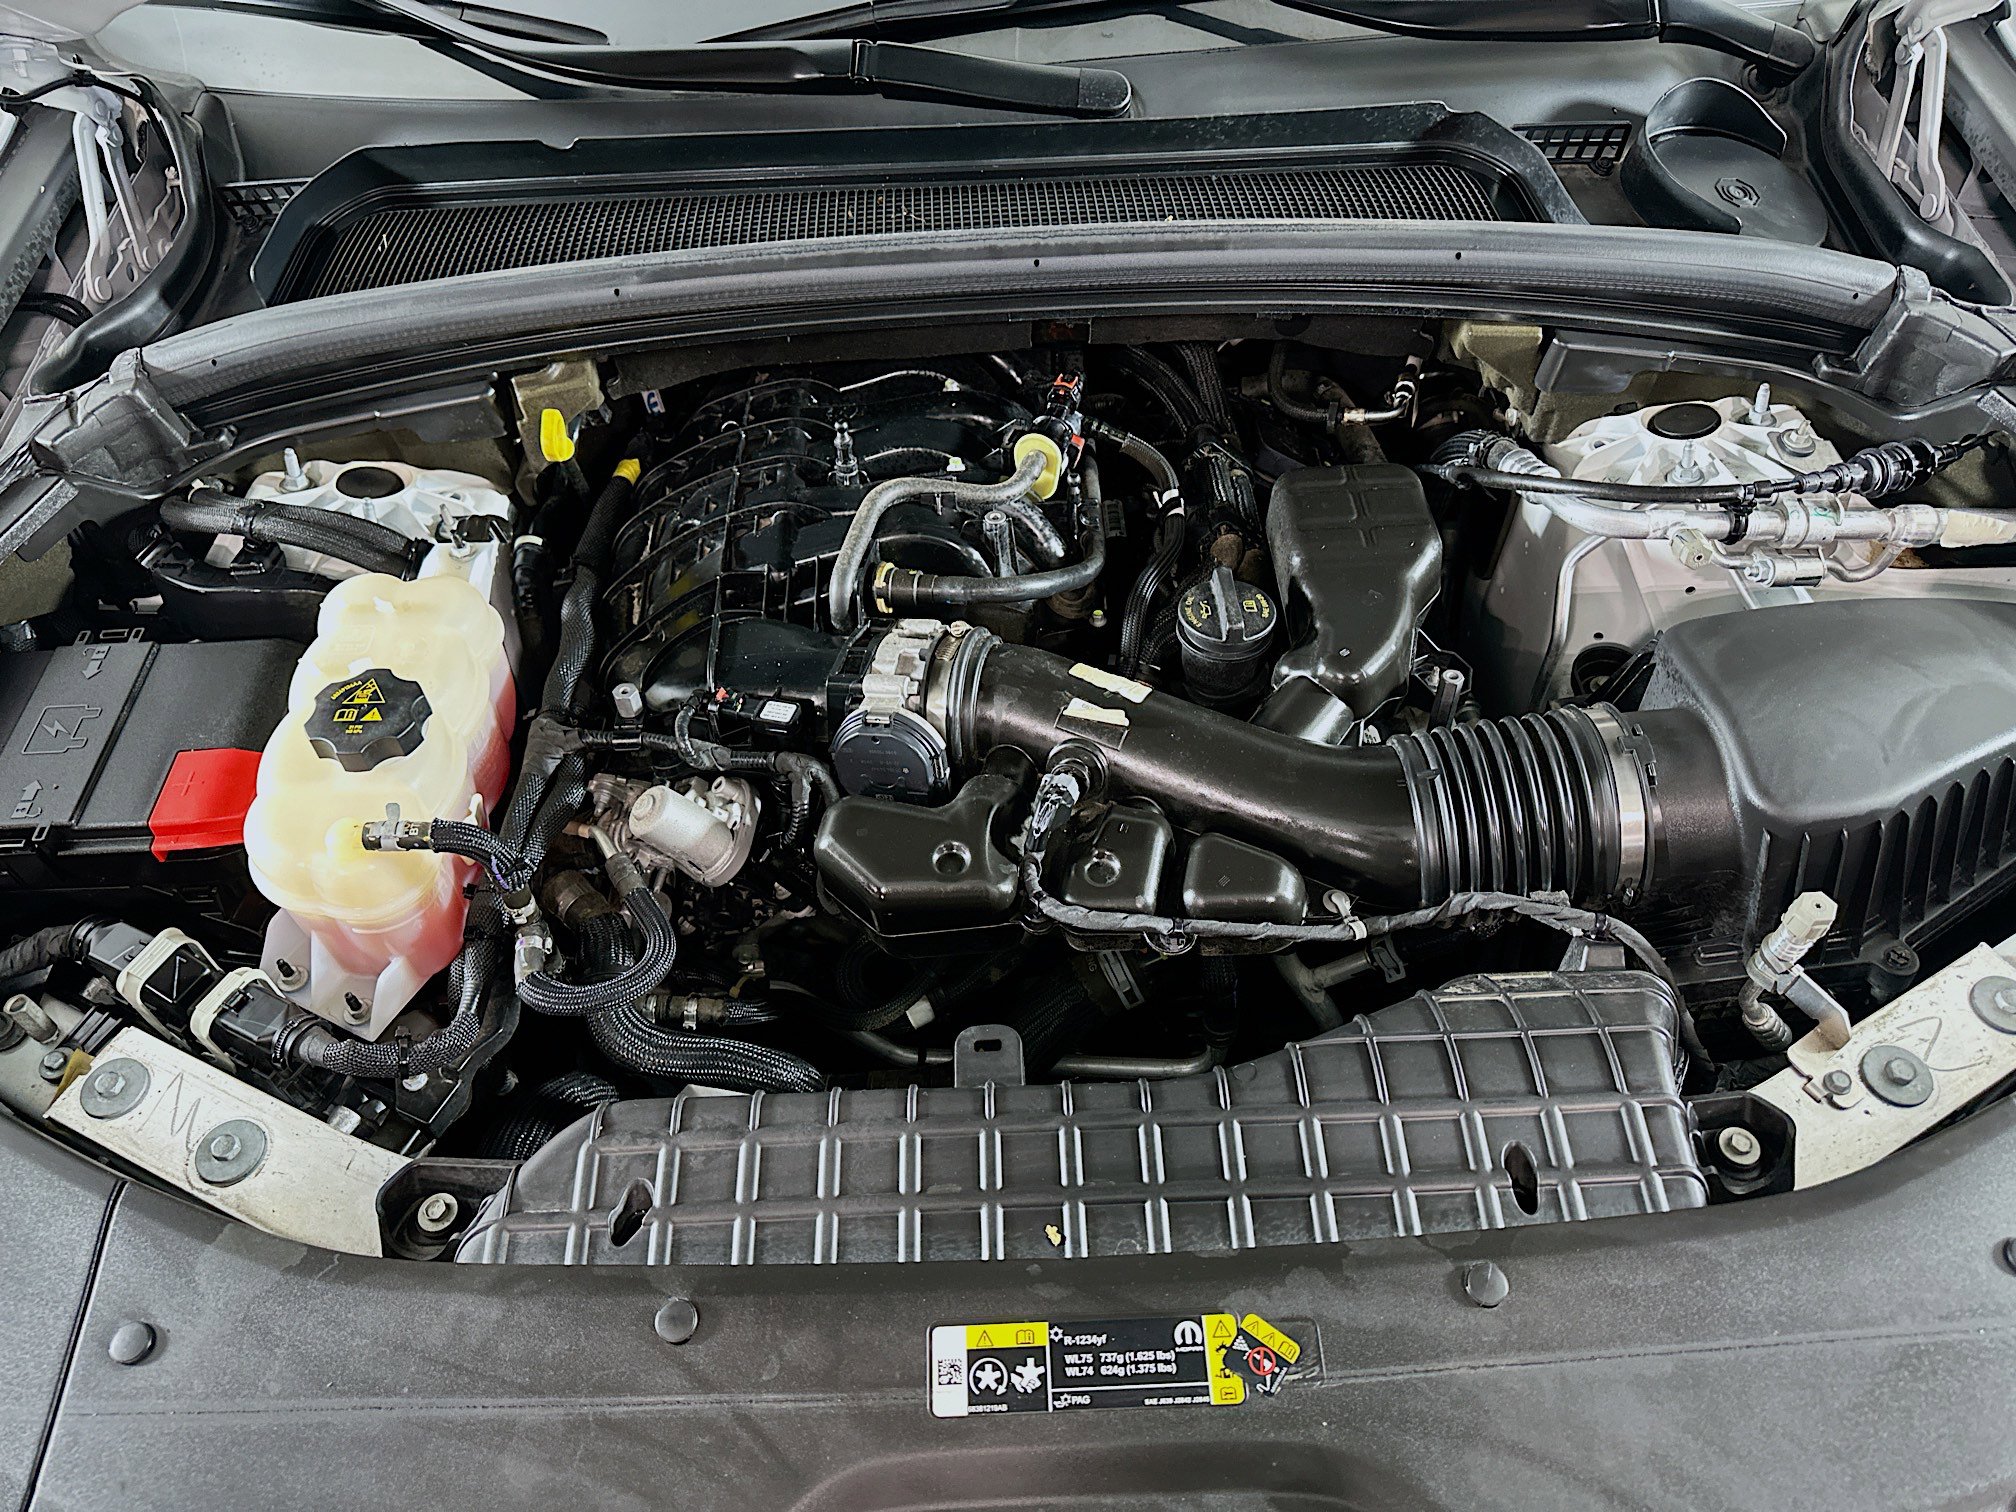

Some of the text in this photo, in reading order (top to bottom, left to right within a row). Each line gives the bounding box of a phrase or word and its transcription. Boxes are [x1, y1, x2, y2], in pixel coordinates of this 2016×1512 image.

[1184, 606, 1203, 628] ENGINE
[1063, 1334, 1107, 1347] R-1234yf
[1064, 1350, 1176, 1364] WL75 737g (1.625 lbs)
[1065, 1363, 1177, 1377] WL74 624g (1.375 lbs)
[1071, 1394, 1091, 1405] PAG
